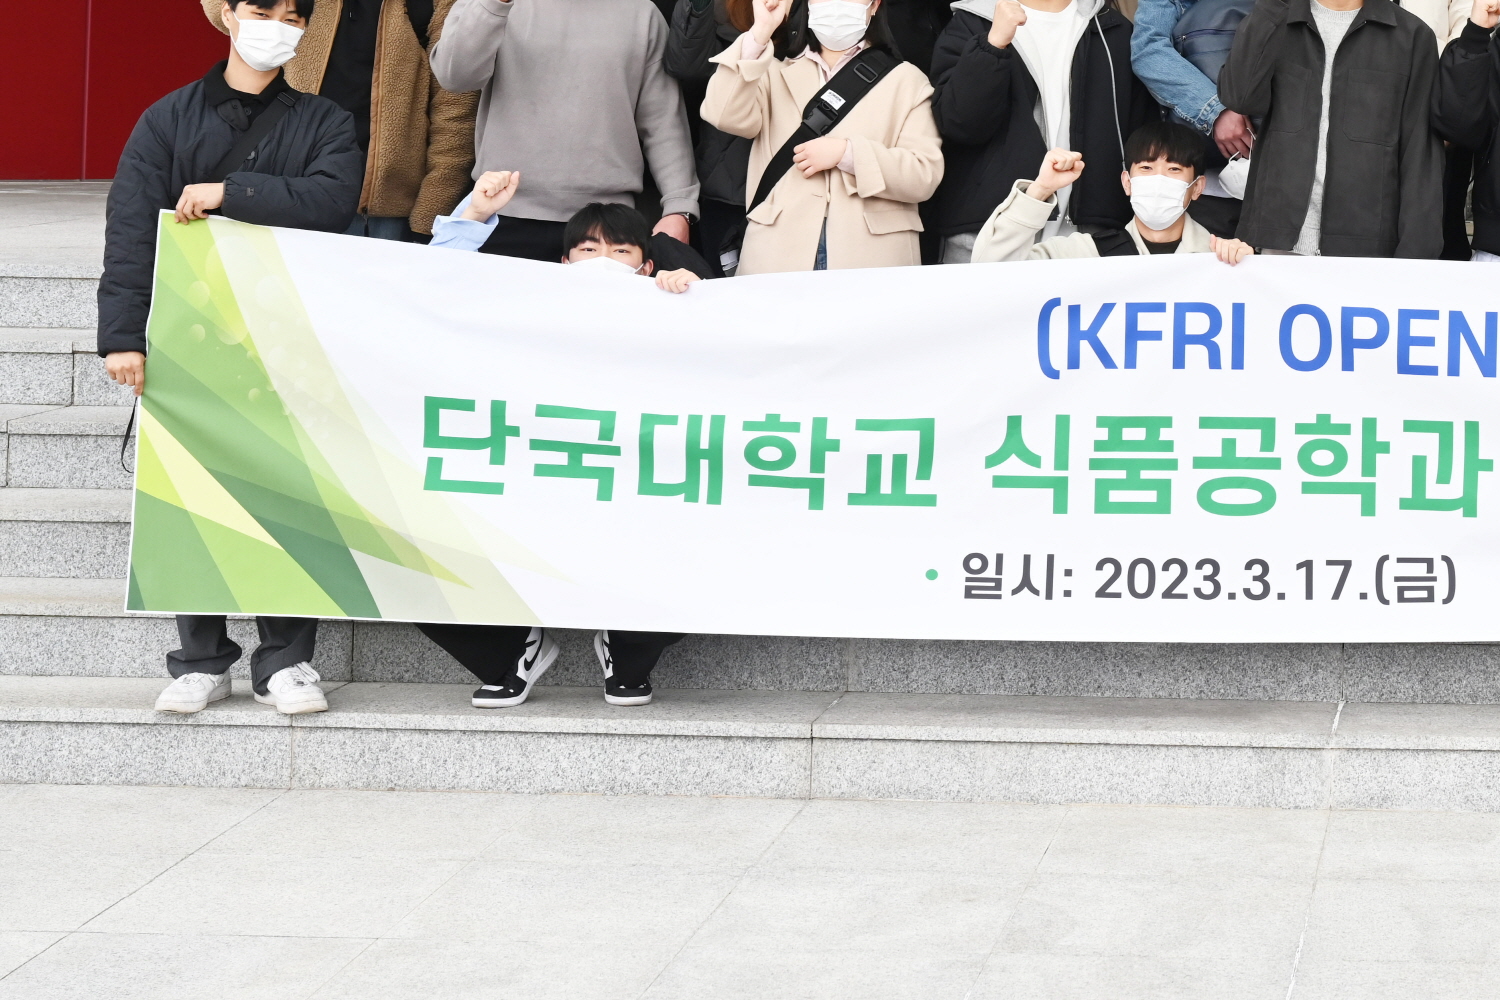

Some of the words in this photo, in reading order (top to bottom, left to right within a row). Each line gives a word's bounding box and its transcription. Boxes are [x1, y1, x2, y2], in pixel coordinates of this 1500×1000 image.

[1037, 298, 1246, 379] (KFRI
[423, 395, 938, 511] 단국대학교
[985, 413, 1494, 518] 식품공학과
[962, 552, 1073, 601] 일시:
[1095, 554, 1456, 606] 2023.3.17.(금)
